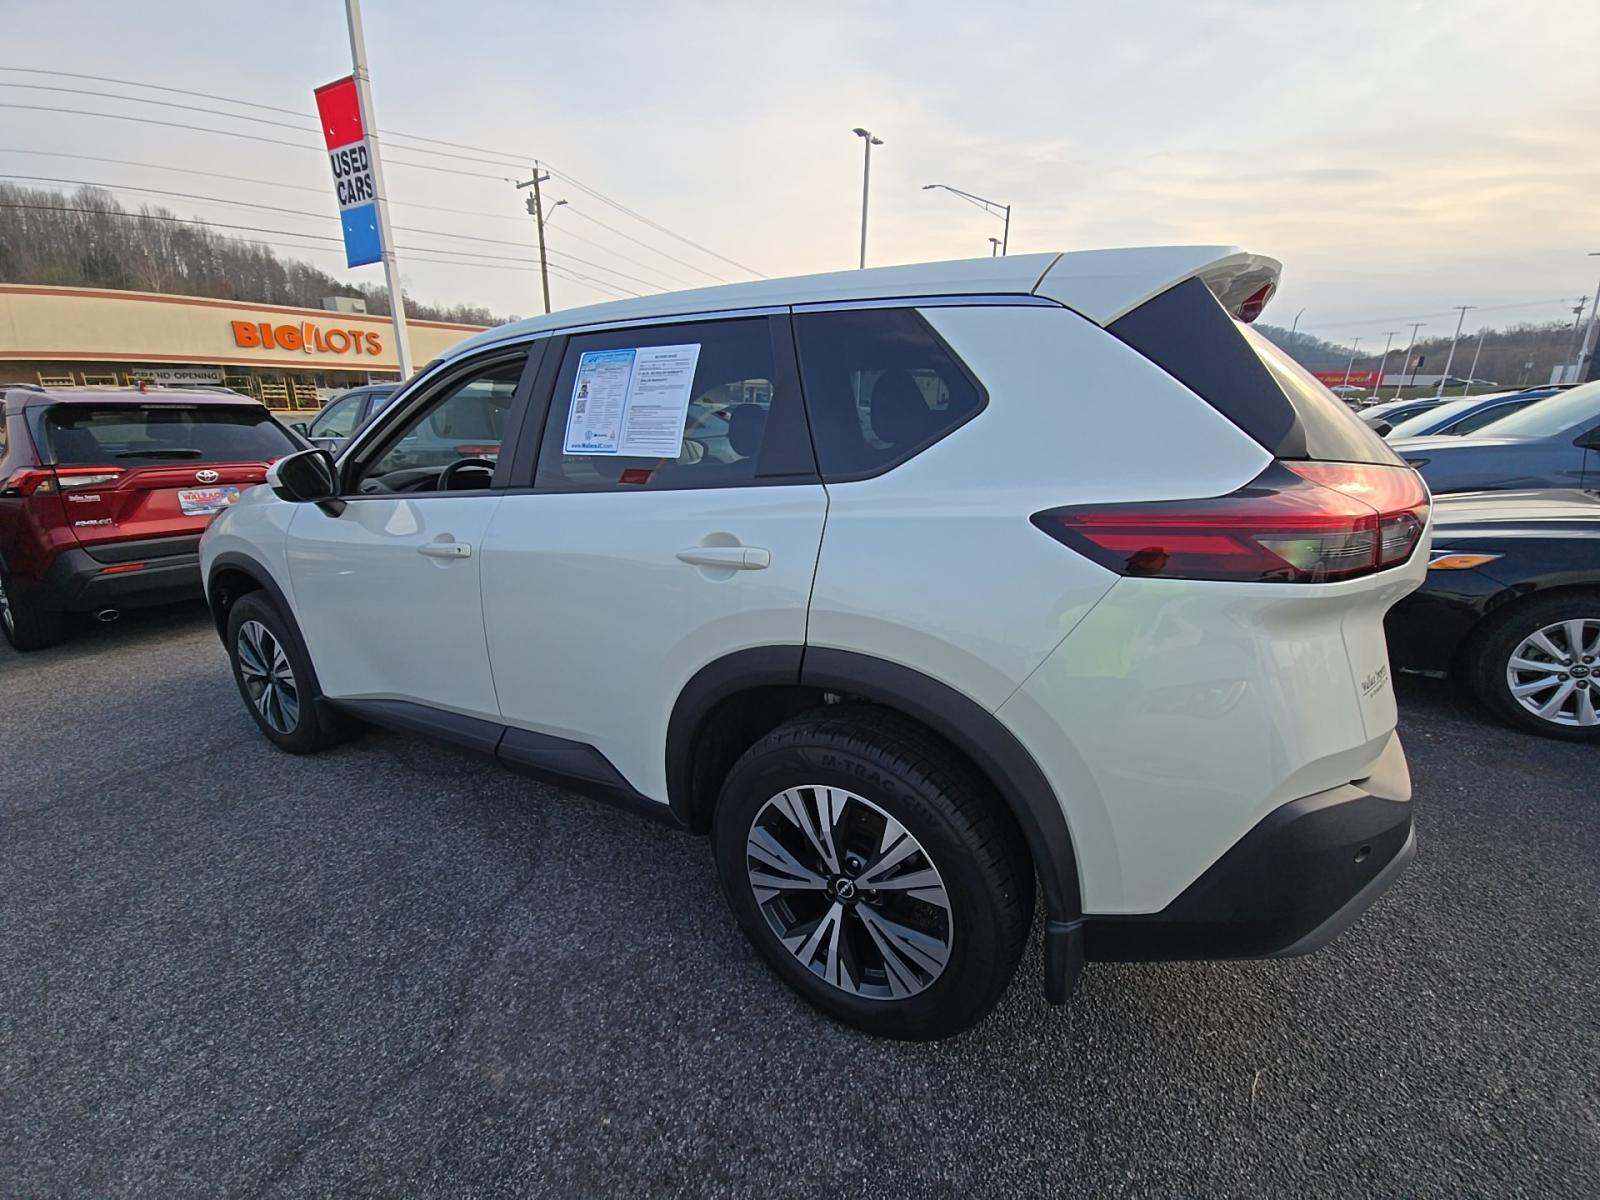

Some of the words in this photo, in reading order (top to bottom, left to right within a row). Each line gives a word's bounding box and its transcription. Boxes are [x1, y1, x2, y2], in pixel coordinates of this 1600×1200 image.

[331, 146, 367, 178] USED
[337, 174, 373, 205] CARS
[314, 328, 383, 355] LOTS
[822, 754, 895, 792] M-TRAC
